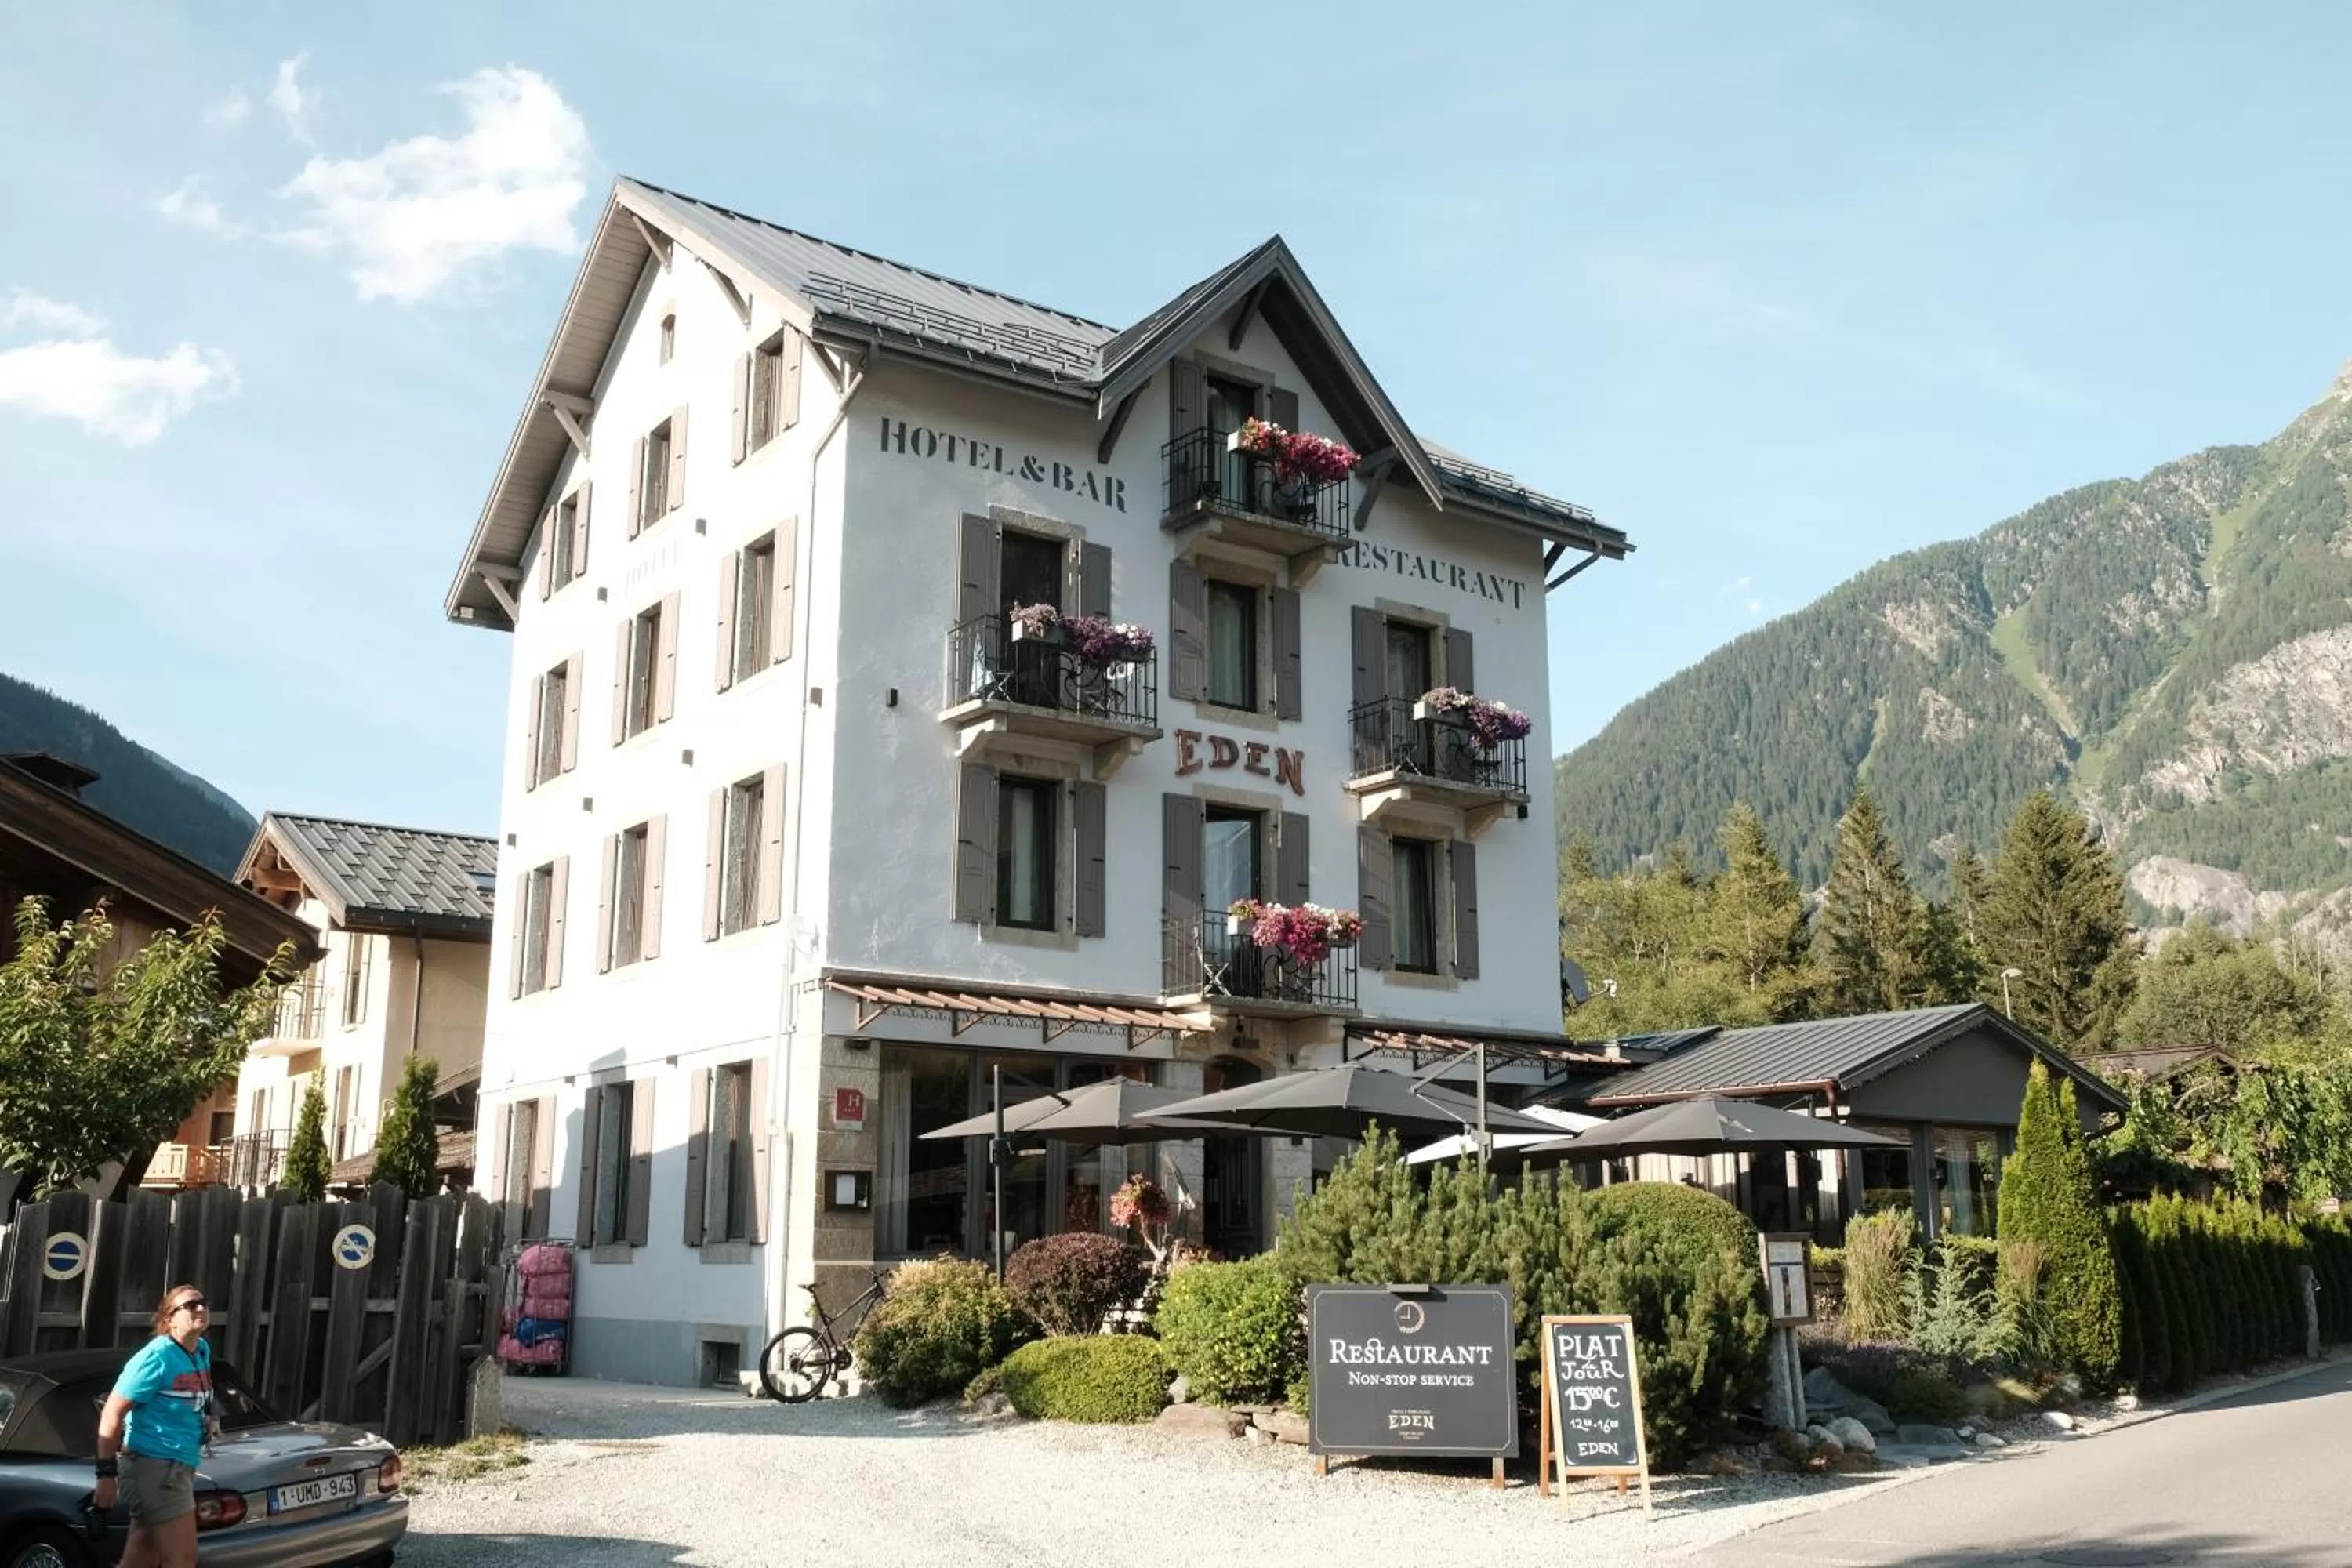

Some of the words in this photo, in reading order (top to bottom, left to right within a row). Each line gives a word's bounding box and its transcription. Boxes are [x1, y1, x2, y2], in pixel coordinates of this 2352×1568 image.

[1174, 728, 1305, 797] EDEN
[1558, 1334, 1622, 1360] PLAT
[1420, 1374, 1475, 1387] SERVICE
[1388, 1414, 1435, 1430] EDEN
[1577, 1442, 1619, 1457] EDEN
